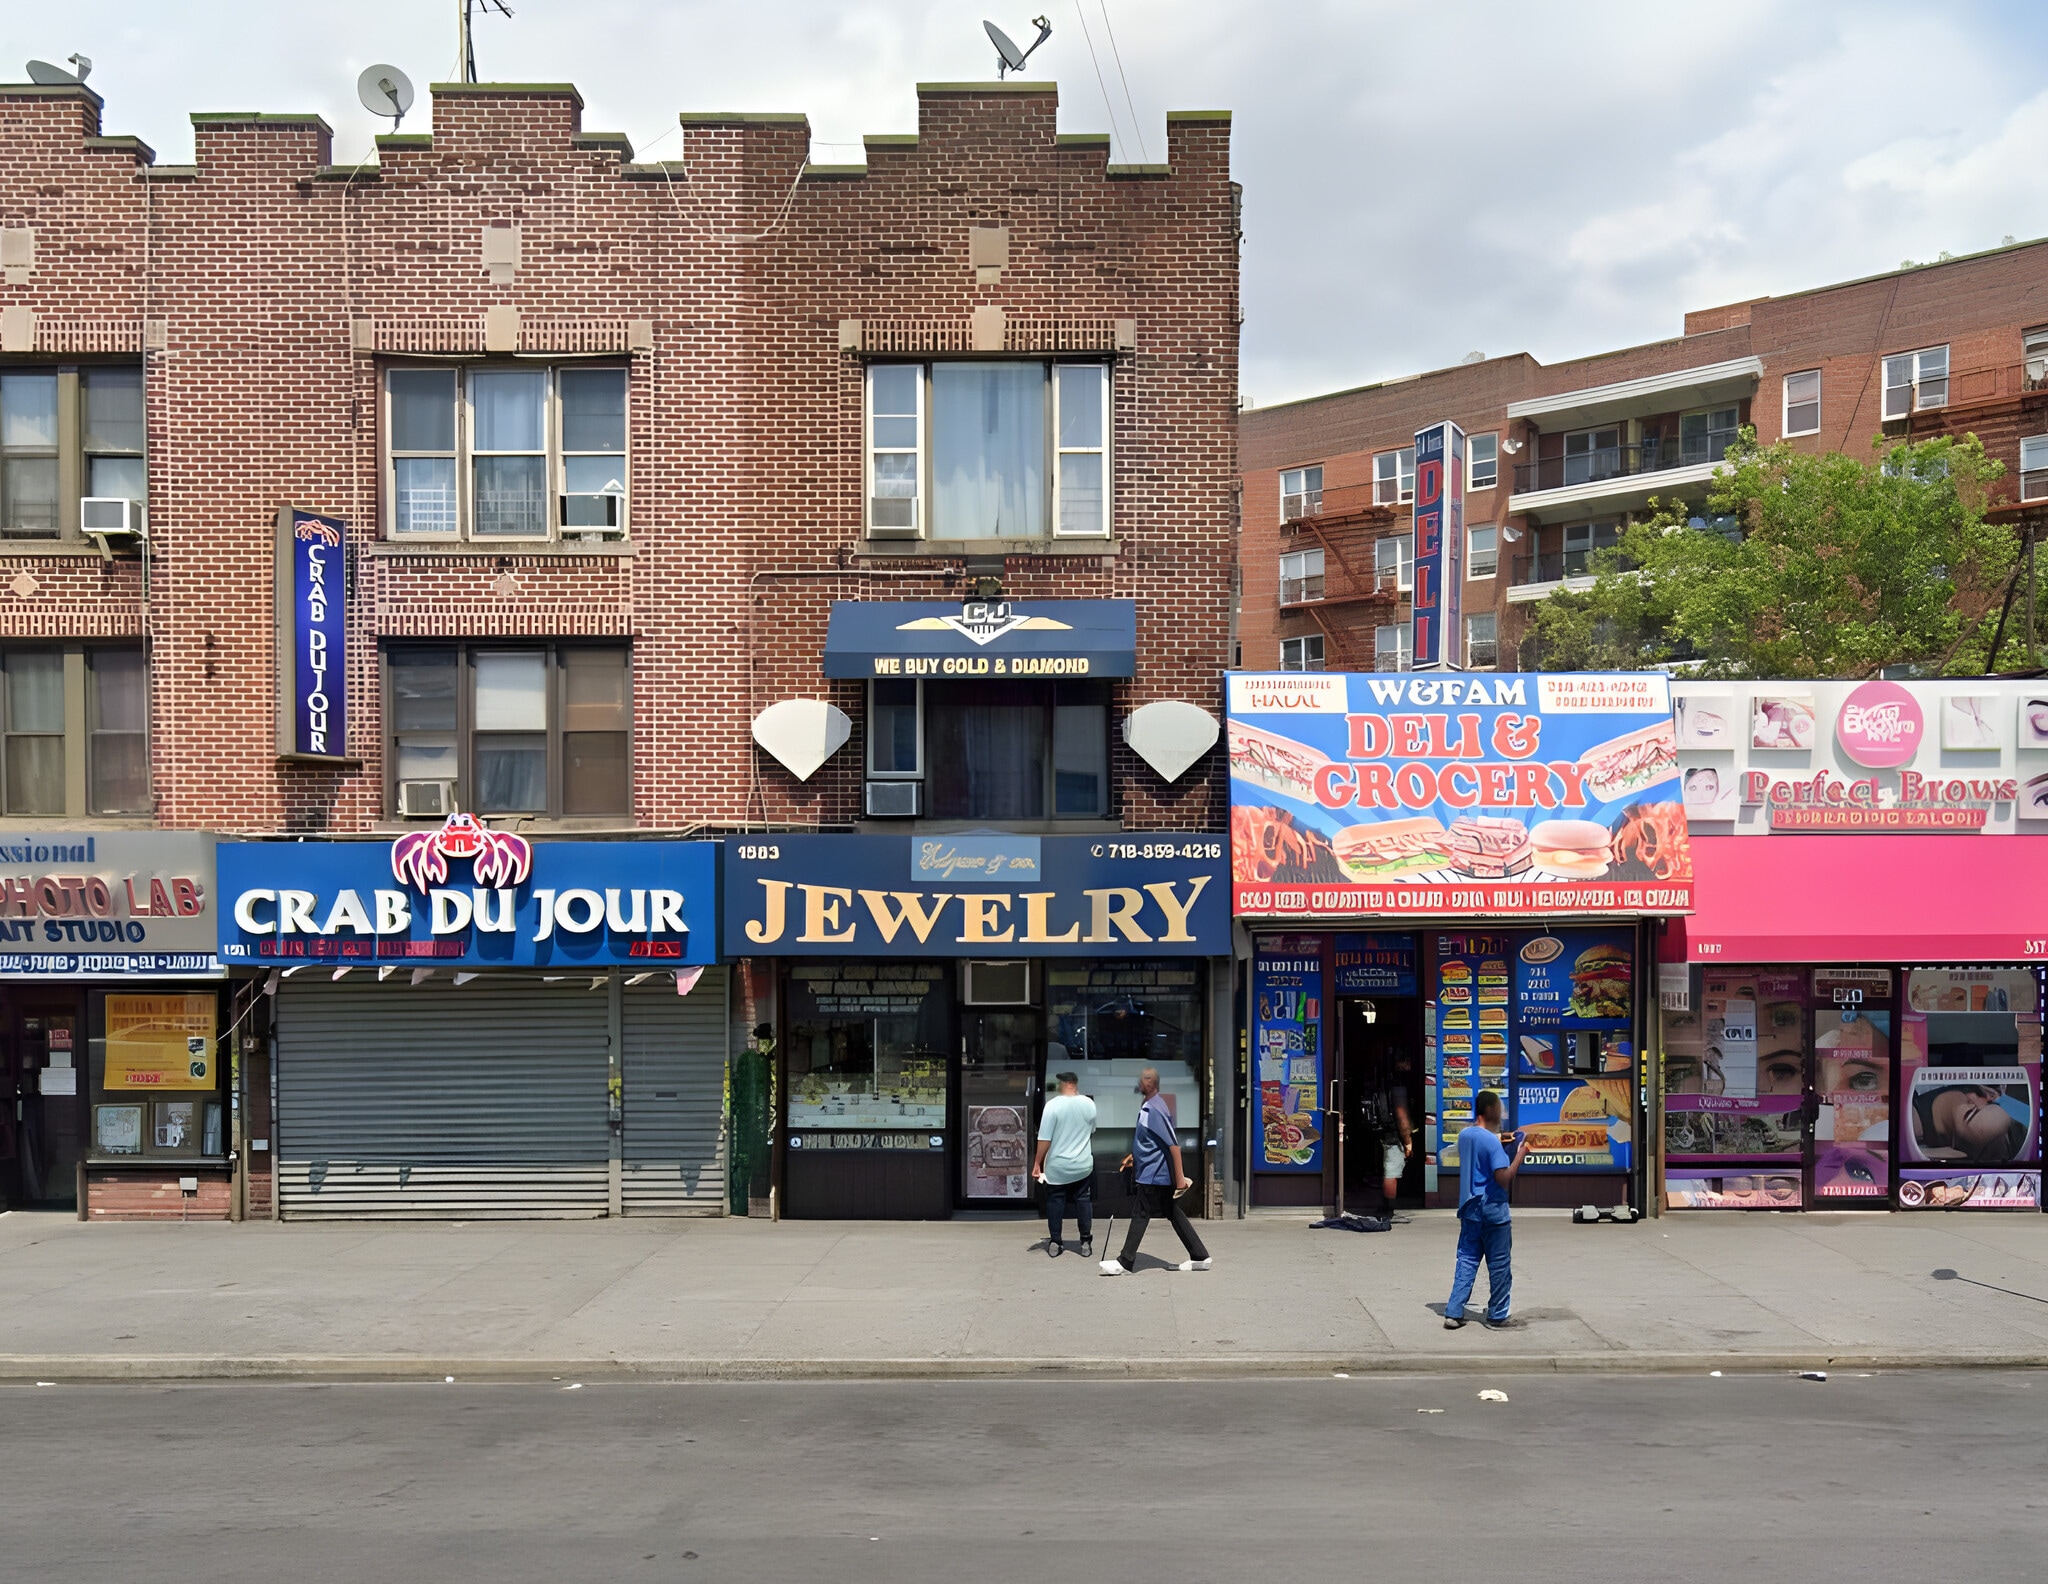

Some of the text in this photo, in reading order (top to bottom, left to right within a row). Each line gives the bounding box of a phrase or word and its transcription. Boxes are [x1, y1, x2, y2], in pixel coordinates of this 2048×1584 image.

[308, 545, 328, 622] CRAB
[1415, 459, 1445, 661] DELI
[874, 657, 1089, 675] WE BUY GOLD & DIAMOND
[1367, 678, 1527, 707] W&FAM
[1344, 711, 1542, 760] DELI &
[1312, 760, 1594, 810] GROCERY
[122, 872, 205, 918] LAB
[234, 886, 691, 942] CRAB DU JOUR
[744, 875, 1213, 944] JEWELRY
[44, 920, 146, 943] STUDIO
